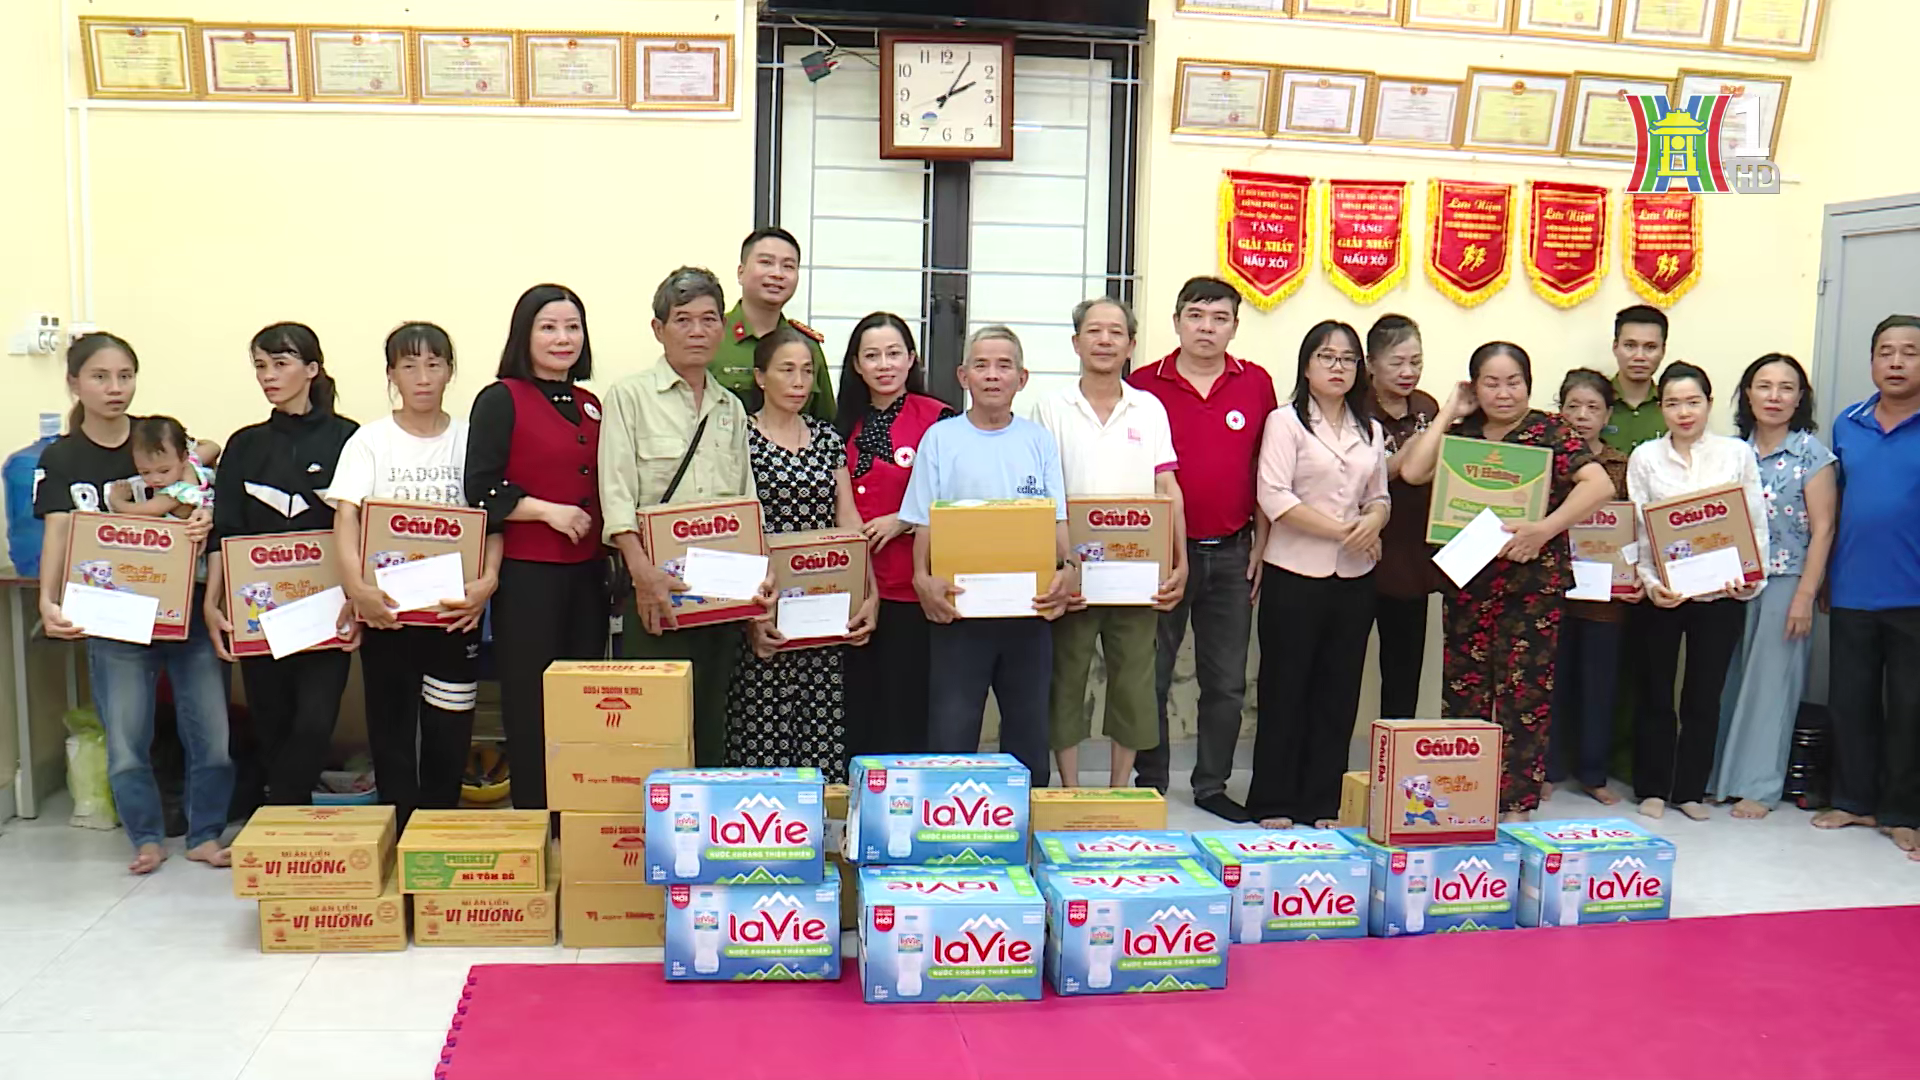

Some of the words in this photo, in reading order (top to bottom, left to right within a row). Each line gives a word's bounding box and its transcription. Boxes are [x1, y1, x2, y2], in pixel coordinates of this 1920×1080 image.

[941, 49, 953, 65] 12
[898, 63, 912, 78] 10
[984, 65, 994, 80] 2
[900, 87, 910, 102] 9
[984, 89, 994, 104] 3
[899, 113, 911, 127] 8
[983, 113, 993, 128] 4
[919, 127, 930, 142] 7
[942, 127, 952, 142] 6
[963, 127, 974, 142] 5
[1250, 221, 1284, 234] TẶNG
[1352, 223, 1382, 234] TẶNG
[1237, 236, 1262, 250] GIẢI
[1264, 238, 1295, 252] NHẤT
[1337, 236, 1362, 248] GIẢI
[1366, 236, 1394, 249] NHẤT
[1243, 253, 1266, 267] NẤU
[1268, 256, 1288, 268] XÔI
[1343, 252, 1368, 264] NẤU
[1370, 253, 1388, 266] XÔI
[388, 466, 461, 482] J'ADORE
[265, 860, 281, 877] VỊ
[293, 914, 309, 931] VỊ
[446, 909, 461, 925] VỊ
